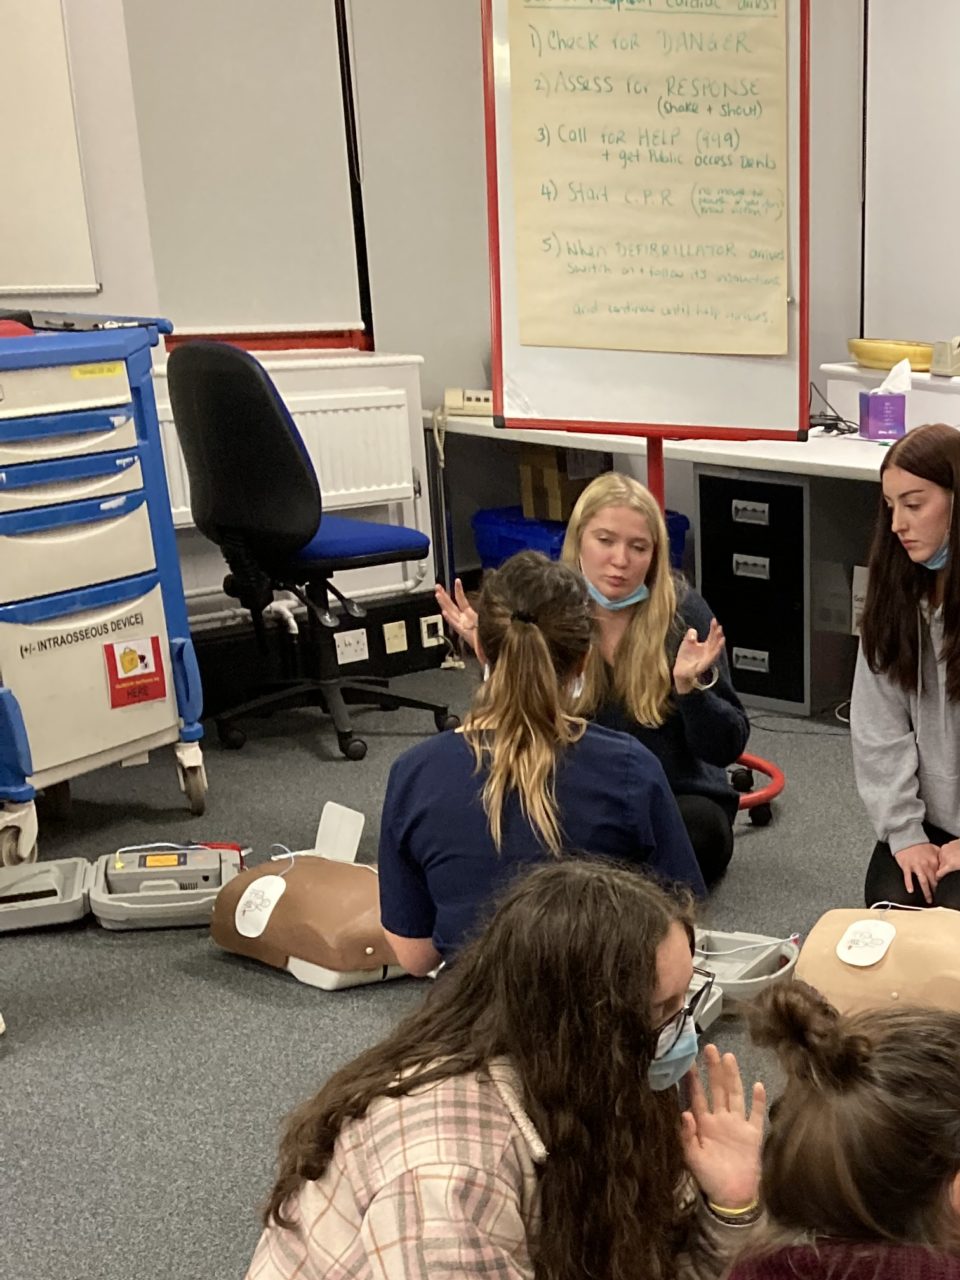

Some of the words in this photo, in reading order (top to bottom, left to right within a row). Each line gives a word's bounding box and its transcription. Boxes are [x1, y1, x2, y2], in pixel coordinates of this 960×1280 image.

[548, 30, 599, 51] Check
[665, 74, 761, 97] RESPONSE
[536, 124, 551, 148] 3)
[557, 123, 587, 144] Call
[638, 126, 682, 149] HELP
[540, 178, 559, 205] 4)
[567, 181, 610, 204] Start
[542, 231, 562, 258] 5)
[37, 624, 110, 652] INTRAOSSEOUS
[110, 612, 145, 633] DEVICE)
